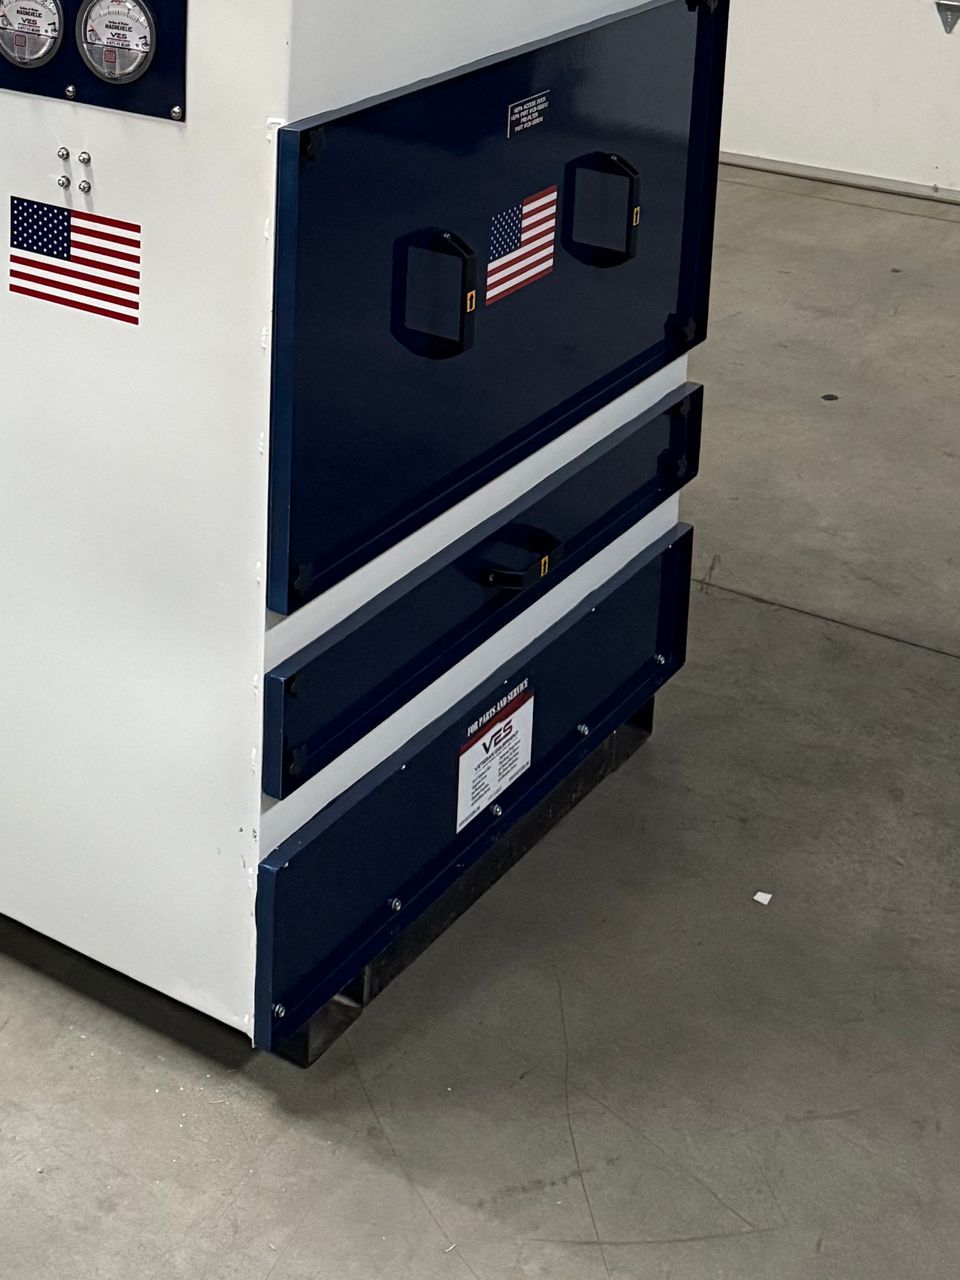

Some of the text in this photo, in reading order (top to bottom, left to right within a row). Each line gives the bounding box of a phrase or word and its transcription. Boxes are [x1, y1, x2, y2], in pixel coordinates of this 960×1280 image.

[467, 677, 528, 737] FOR PARTS AND SERVICE
[482, 719, 513, 754] VES
